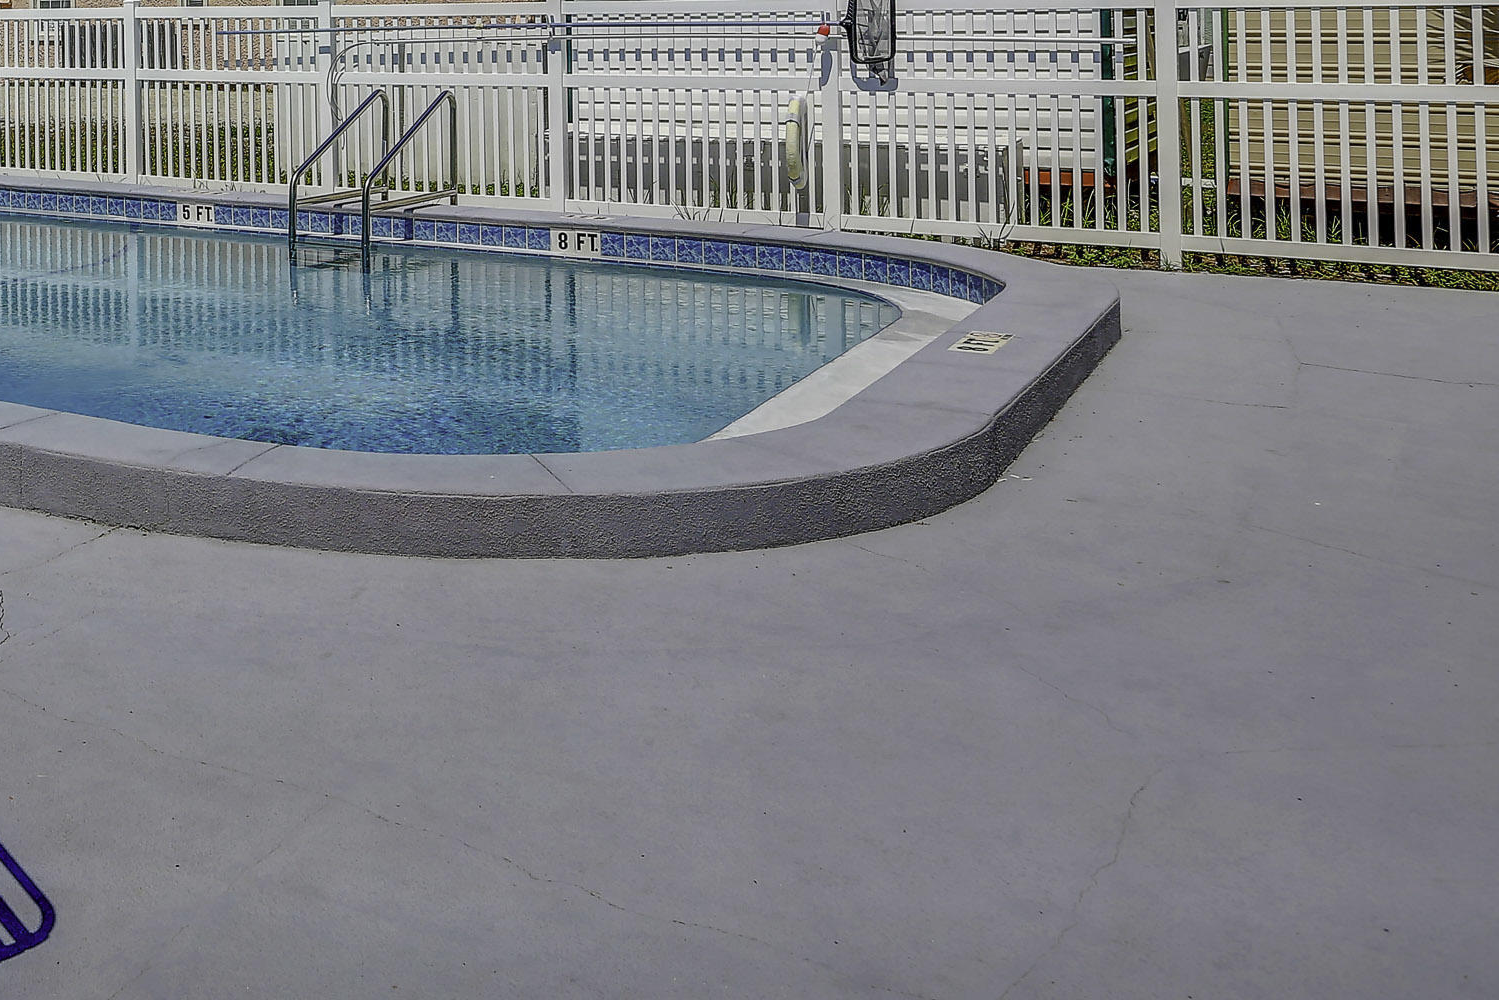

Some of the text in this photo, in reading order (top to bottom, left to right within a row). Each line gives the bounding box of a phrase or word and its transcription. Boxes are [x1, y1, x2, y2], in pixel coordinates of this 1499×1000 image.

[182, 204, 213, 222] 5 FT.
[558, 231, 598, 251] 8 FT.
